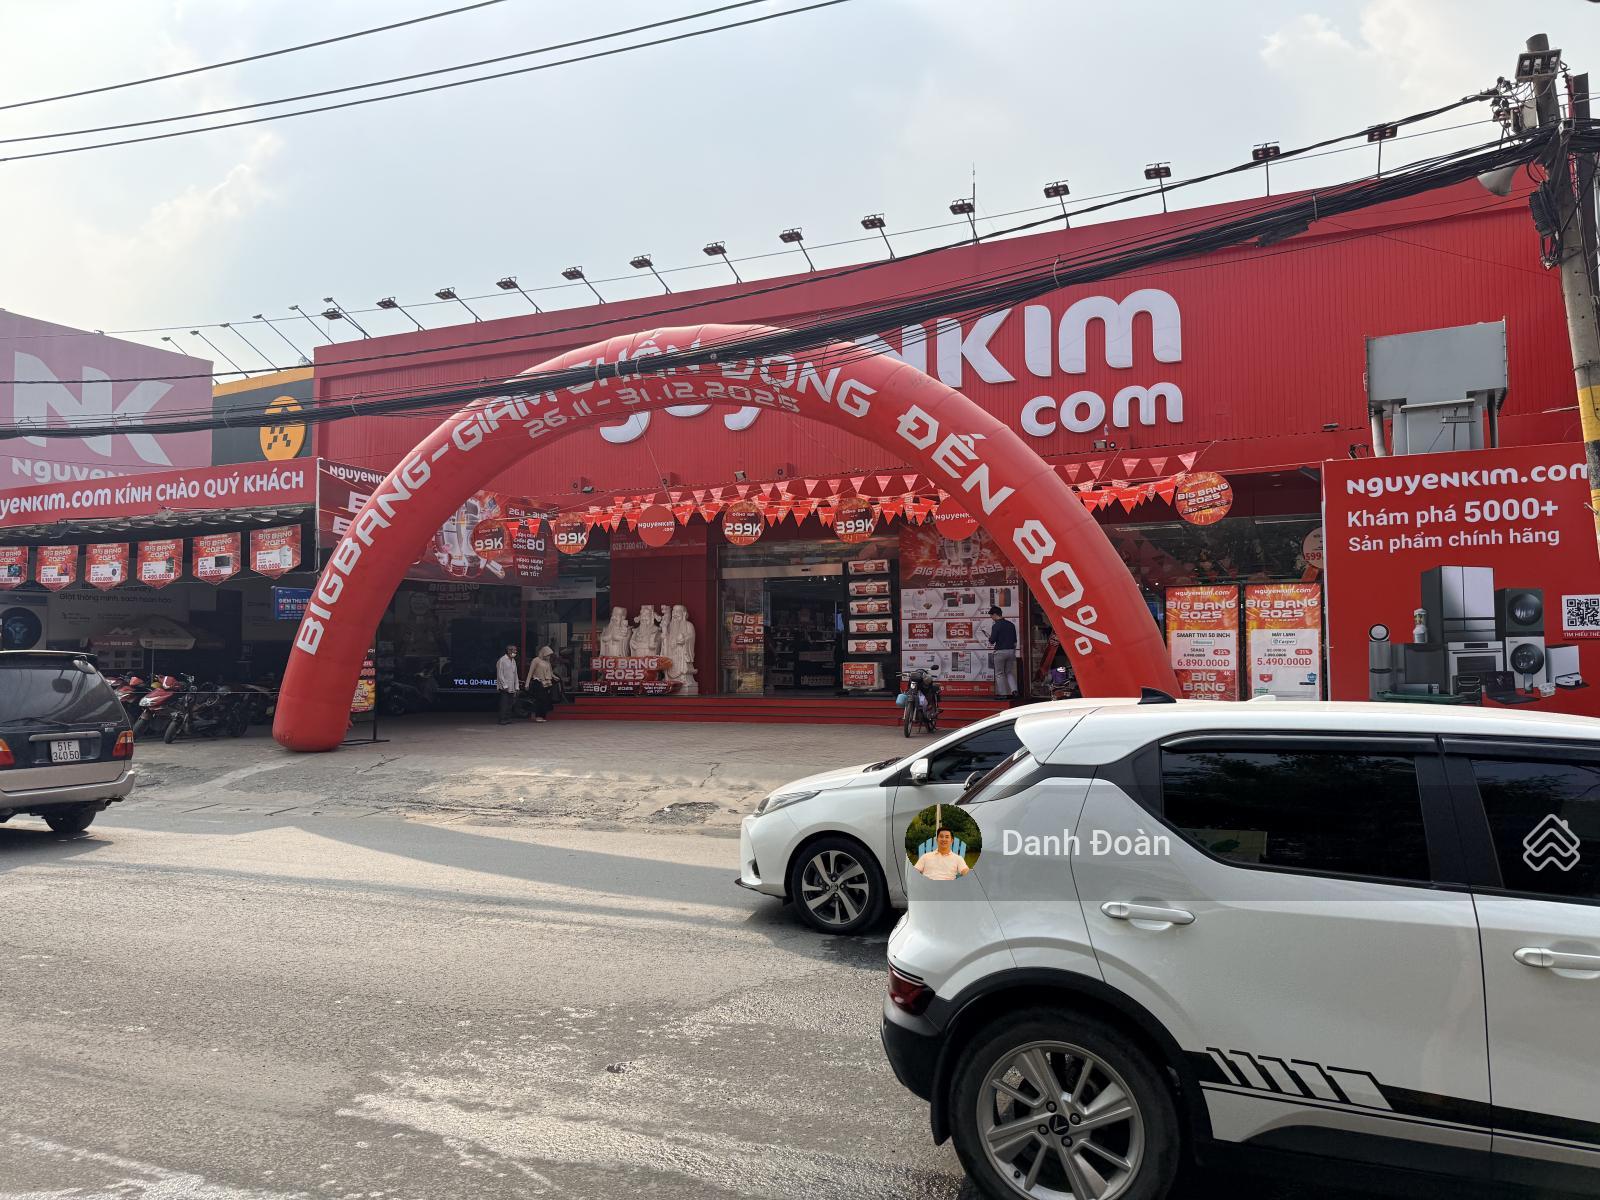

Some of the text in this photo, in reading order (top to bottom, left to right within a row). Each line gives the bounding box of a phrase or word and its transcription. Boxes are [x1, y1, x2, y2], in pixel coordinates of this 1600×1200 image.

[14, 351, 174, 467] NK
[1020, 381, 1184, 437] com
[115, 482, 152, 505] KÍNH
[155, 476, 200, 501] CHÀO
[203, 471, 239, 498] QUÝ
[243, 467, 304, 493] KHÁCH
[1198, 483, 1229, 498] BANG
[1188, 492, 1221, 506] 2025
[1348, 498, 1559, 528] Khám phá 5000+
[724, 522, 762, 536] 299K
[836, 519, 875, 534] 399K
[896, 404, 1015, 516] ĐẾN
[1012, 520, 1111, 656] 80%
[474, 537, 503, 550] 99K
[554, 532, 588, 545] 199K
[1348, 528, 1560, 553] Sản phẩm chính hãng
[1166, 600, 1236, 610] BIG BANG
[1245, 598, 1318, 608] BIG BANG
[734, 614, 754, 624] BIG
[1180, 610, 1222, 619] 2025
[1260, 609, 1304, 618] 2025
[744, 626, 764, 634] 20
[592, 658, 658, 668] BIG BANG
[1177, 659, 1230, 667] 6.890.000Đ
[1257, 658, 1312, 666] 5.490.000Đ
[606, 670, 645, 680] 2025
[1192, 672, 1216, 681] BIG
[1183, 683, 1226, 692] BANG
